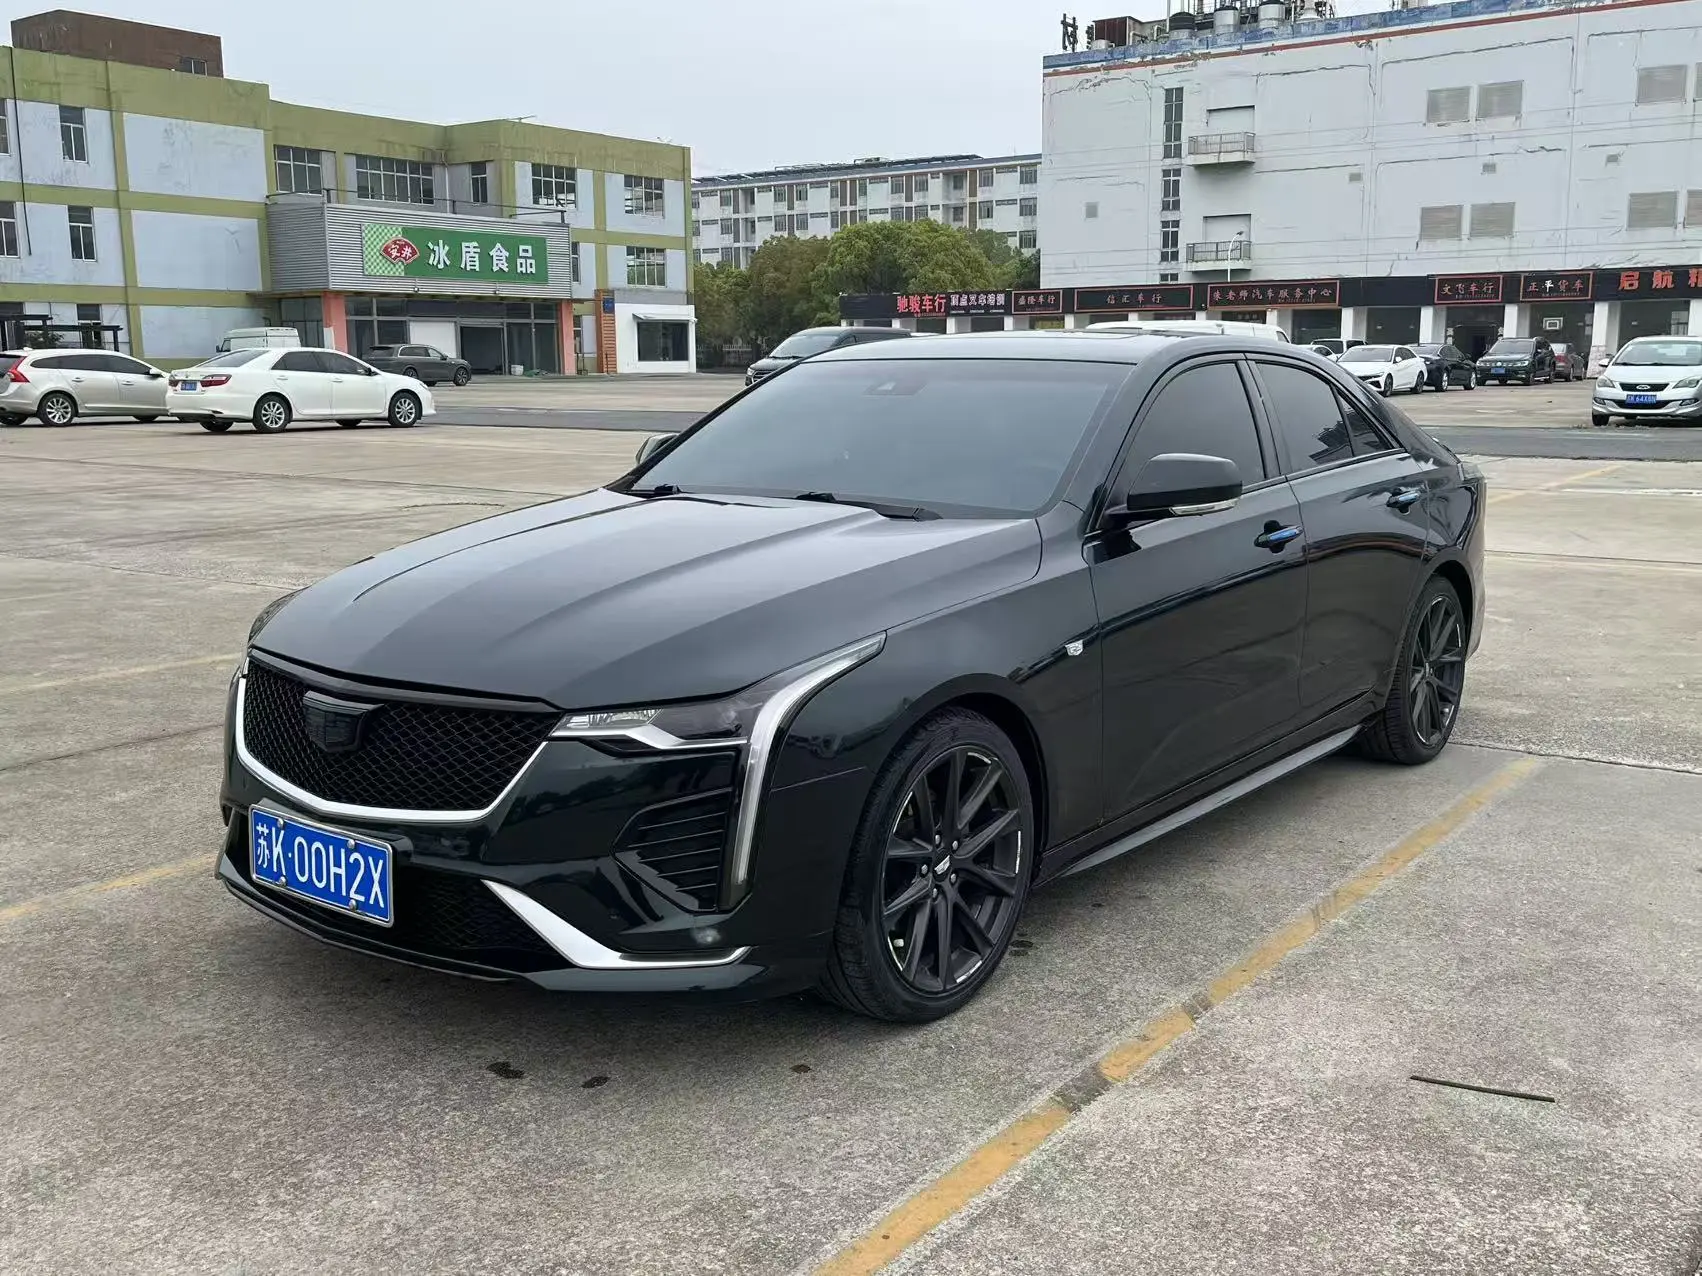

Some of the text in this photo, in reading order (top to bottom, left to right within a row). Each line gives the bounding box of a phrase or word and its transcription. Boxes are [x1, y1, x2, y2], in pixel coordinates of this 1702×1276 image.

[388, 244, 413, 260] 安井
[427, 239, 536, 275] 冰盾食品
[1441, 282, 1495, 295] 文飞车行
[1527, 279, 1584, 293] 正平货车
[1106, 291, 1163, 304] 信汇车行
[1213, 287, 1332, 301] 朱老师汽车服务中心
[896, 293, 947, 313] 驰骏车行
